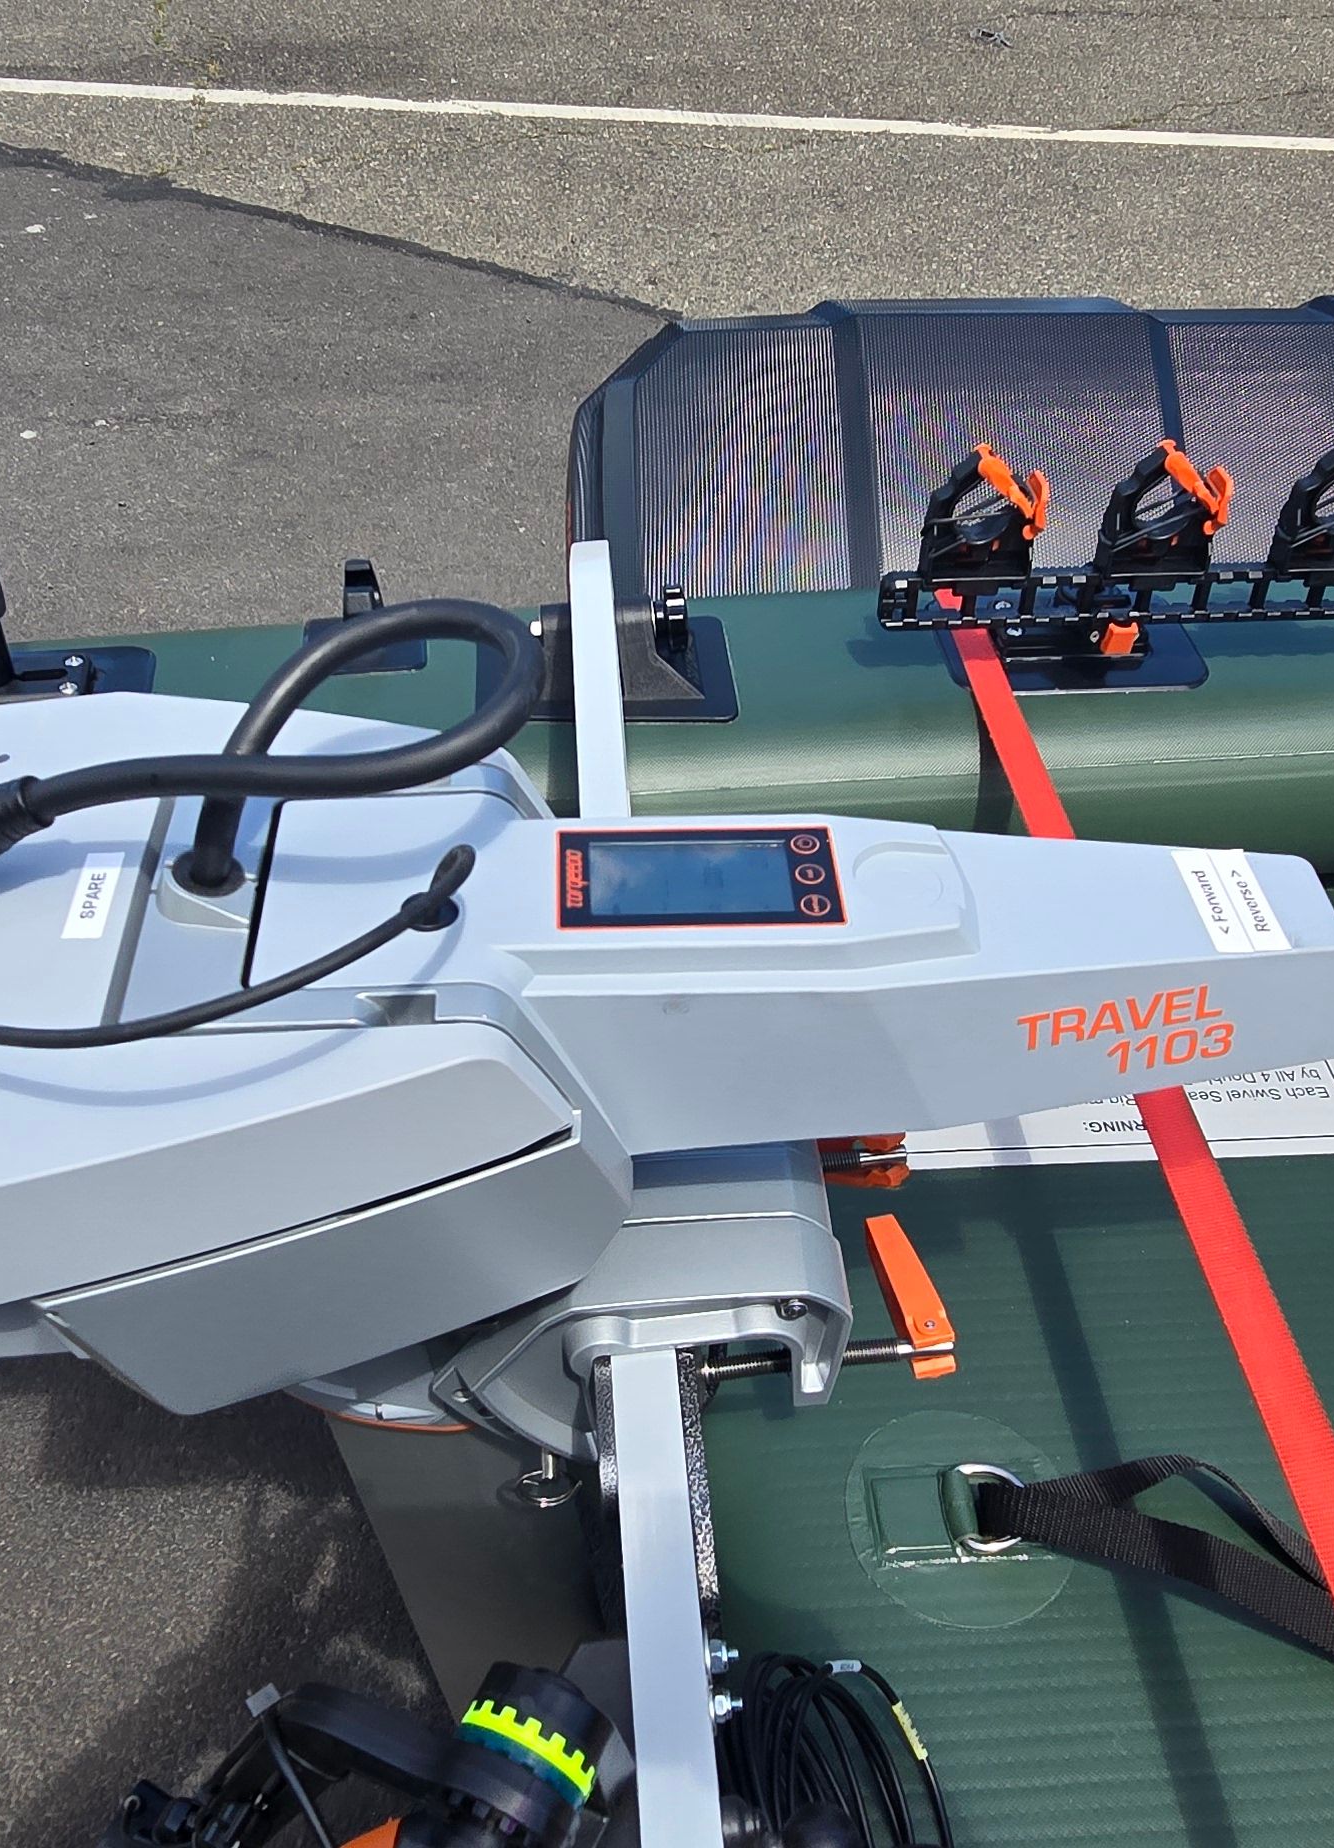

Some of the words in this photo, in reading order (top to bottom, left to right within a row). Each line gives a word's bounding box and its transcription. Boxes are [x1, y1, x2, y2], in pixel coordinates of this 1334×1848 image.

[79, 872, 107, 919] SPARE
[1190, 869, 1229, 922] Forward
[1236, 880, 1271, 932] Reverse
[1016, 984, 1224, 1051] TRAVEL
[1106, 1022, 1236, 1075] 1103
[1260, 1071, 1271, 1082] 4
[1274, 1070, 1296, 1082] All
[1300, 1066, 1321, 1080] by
[1187, 1090, 1222, 1102] Sea
[1225, 1088, 1282, 1101] Swivel
[1285, 1086, 1330, 1099] Each
[1082, 1119, 1148, 1133] RNING:
